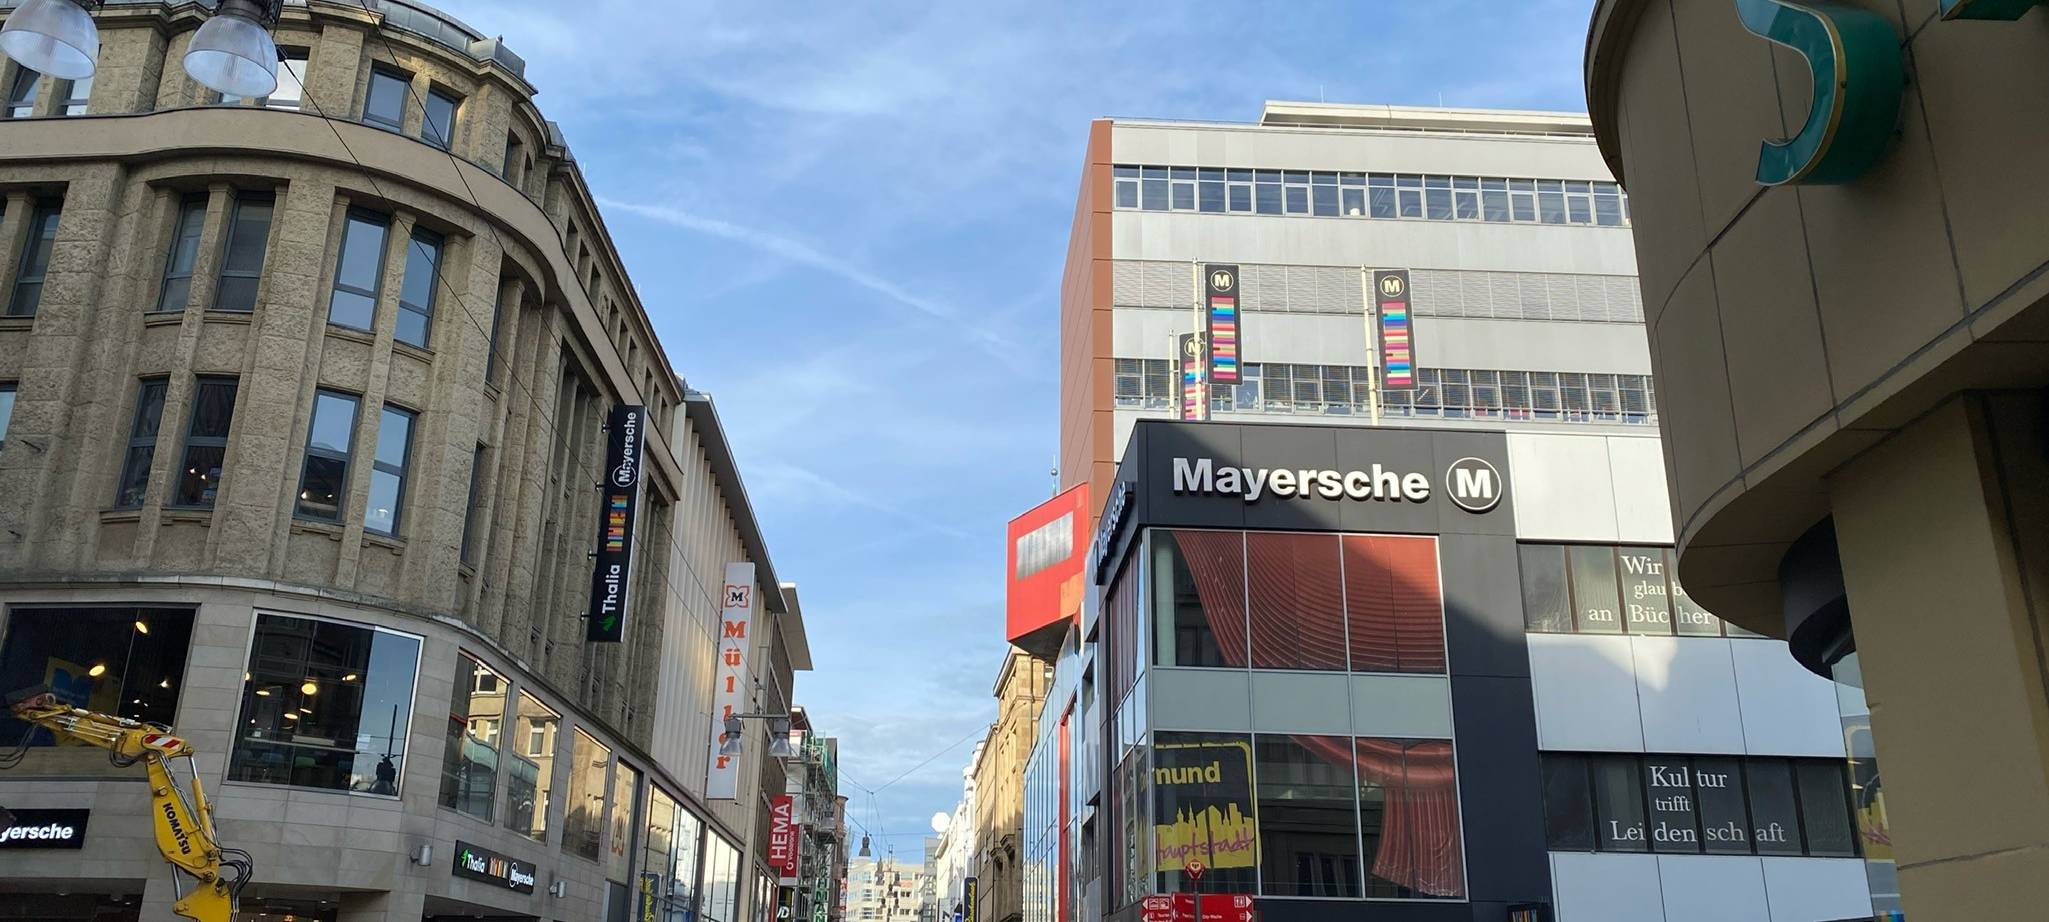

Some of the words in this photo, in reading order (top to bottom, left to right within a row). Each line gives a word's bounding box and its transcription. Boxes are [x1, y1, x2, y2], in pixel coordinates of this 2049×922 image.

[618, 412, 637, 483] Mayersche
[1173, 457, 1430, 501] Mayersche
[1621, 555, 1663, 574] Wir
[602, 564, 621, 614] Thalia
[1588, 608, 1613, 621] an
[1630, 604, 1713, 624] Bücher
[1649, 765, 1727, 788] Kultur
[1655, 796, 1691, 811] trifft
[162, 803, 191, 855] KOMATSU
[771, 803, 790, 859] HEMA
[1610, 820, 1786, 842] Leidenschaft
[467, 853, 485, 873] Thalia
